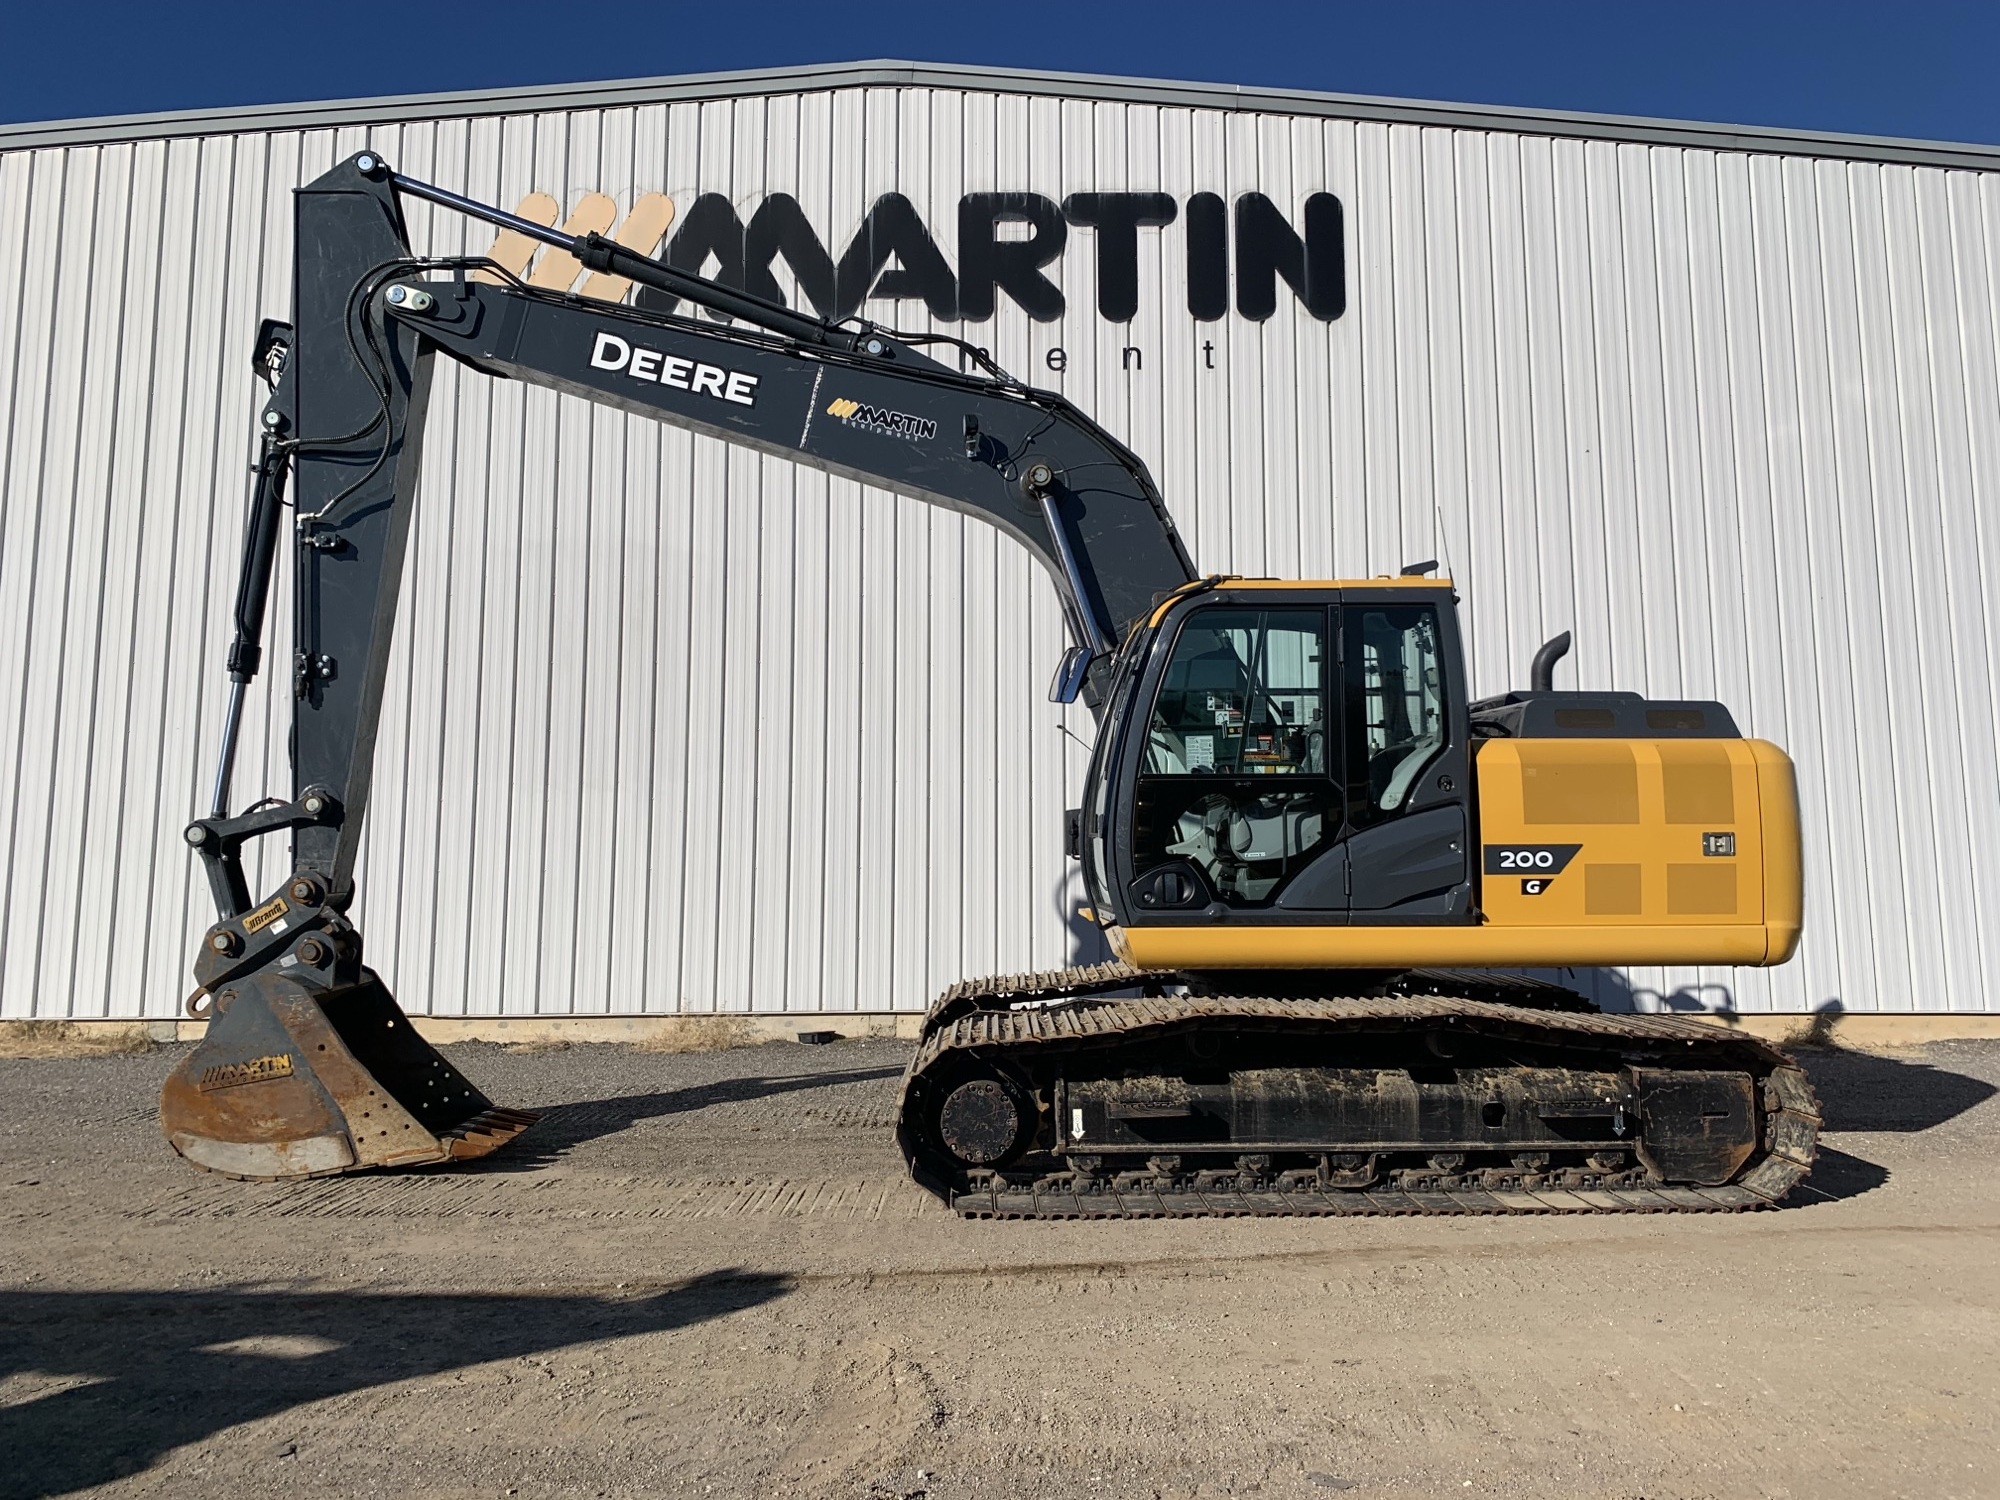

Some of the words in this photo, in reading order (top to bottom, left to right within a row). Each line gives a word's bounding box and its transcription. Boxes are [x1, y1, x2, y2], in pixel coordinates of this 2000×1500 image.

[637, 192, 1345, 322] MARTIN
[590, 332, 758, 406] DEERE
[850, 404, 937, 439] MARTIN
[1500, 851, 1553, 868] 200
[1526, 880, 1541, 894] G
[221, 1053, 293, 1079] MARTIN
